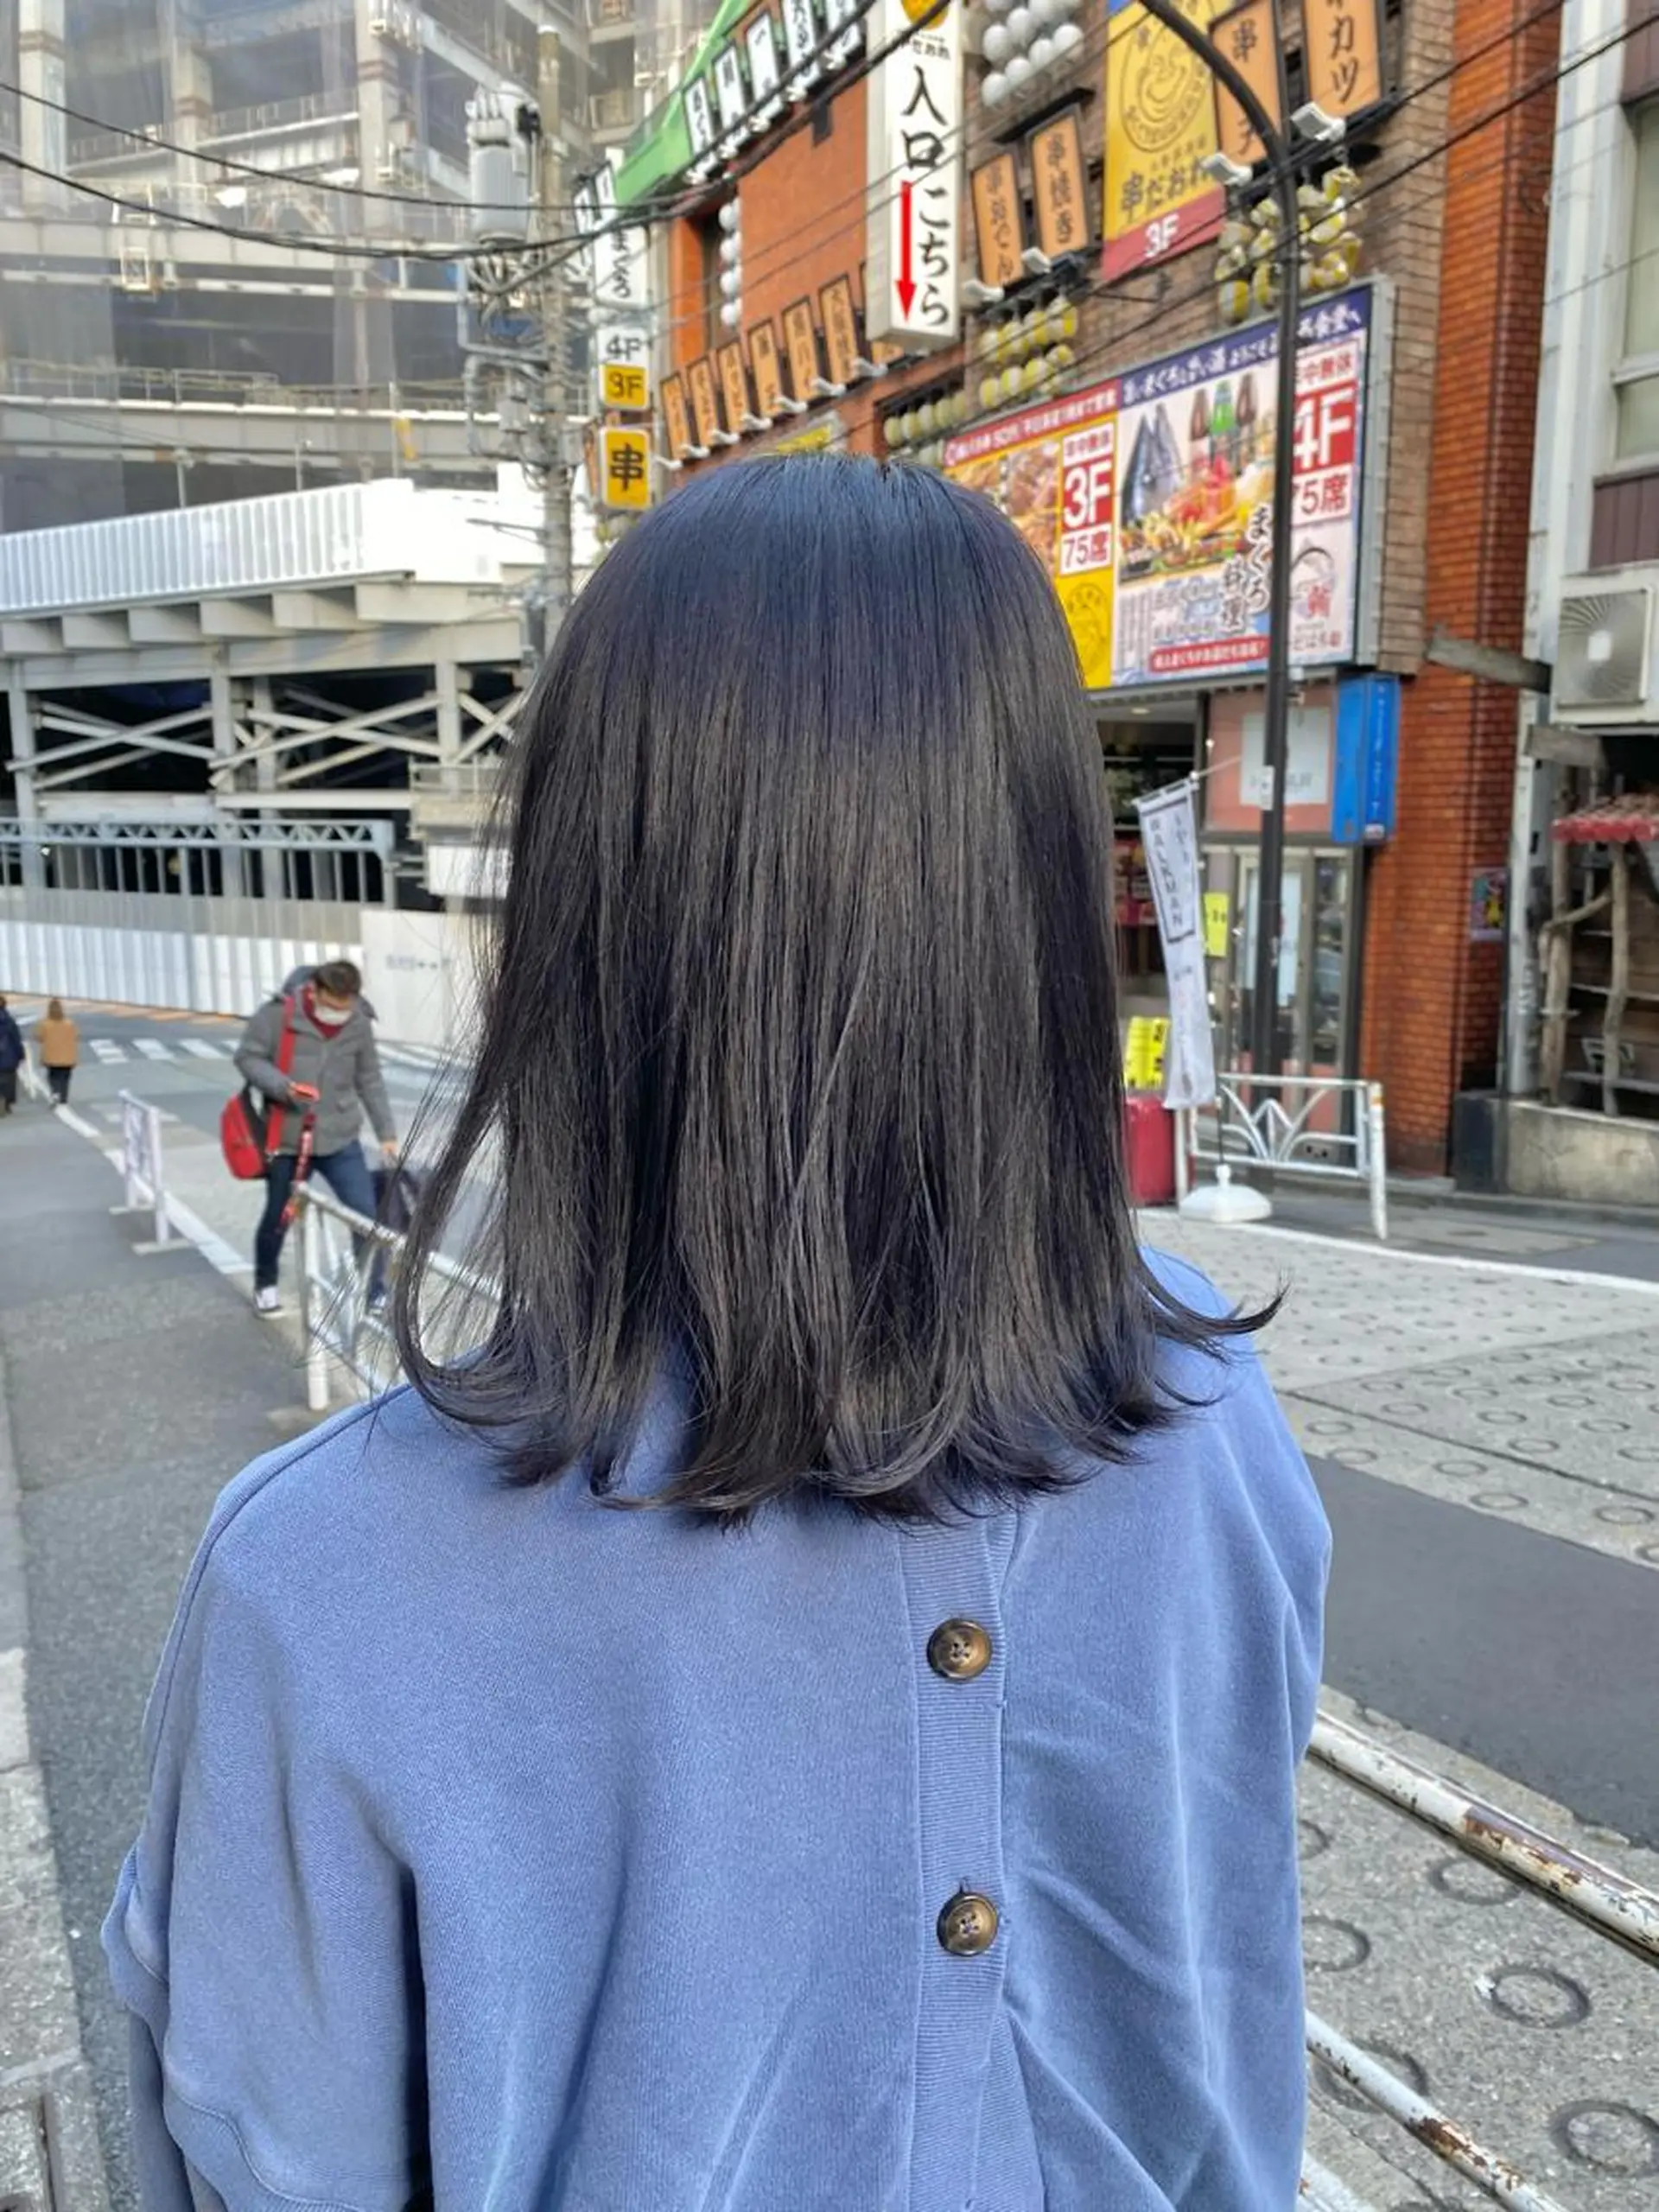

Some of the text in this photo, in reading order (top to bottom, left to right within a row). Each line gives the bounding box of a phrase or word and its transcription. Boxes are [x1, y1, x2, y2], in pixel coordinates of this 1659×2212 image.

[1328, 0, 1359, 104] カツ
[900, 64, 950, 327] 入口こちら
[1144, 213, 1179, 259] 3F
[607, 372, 643, 399] 3F
[1294, 388, 1354, 469] 4F
[610, 442, 645, 492] 串
[1063, 460, 1112, 529] 3F
